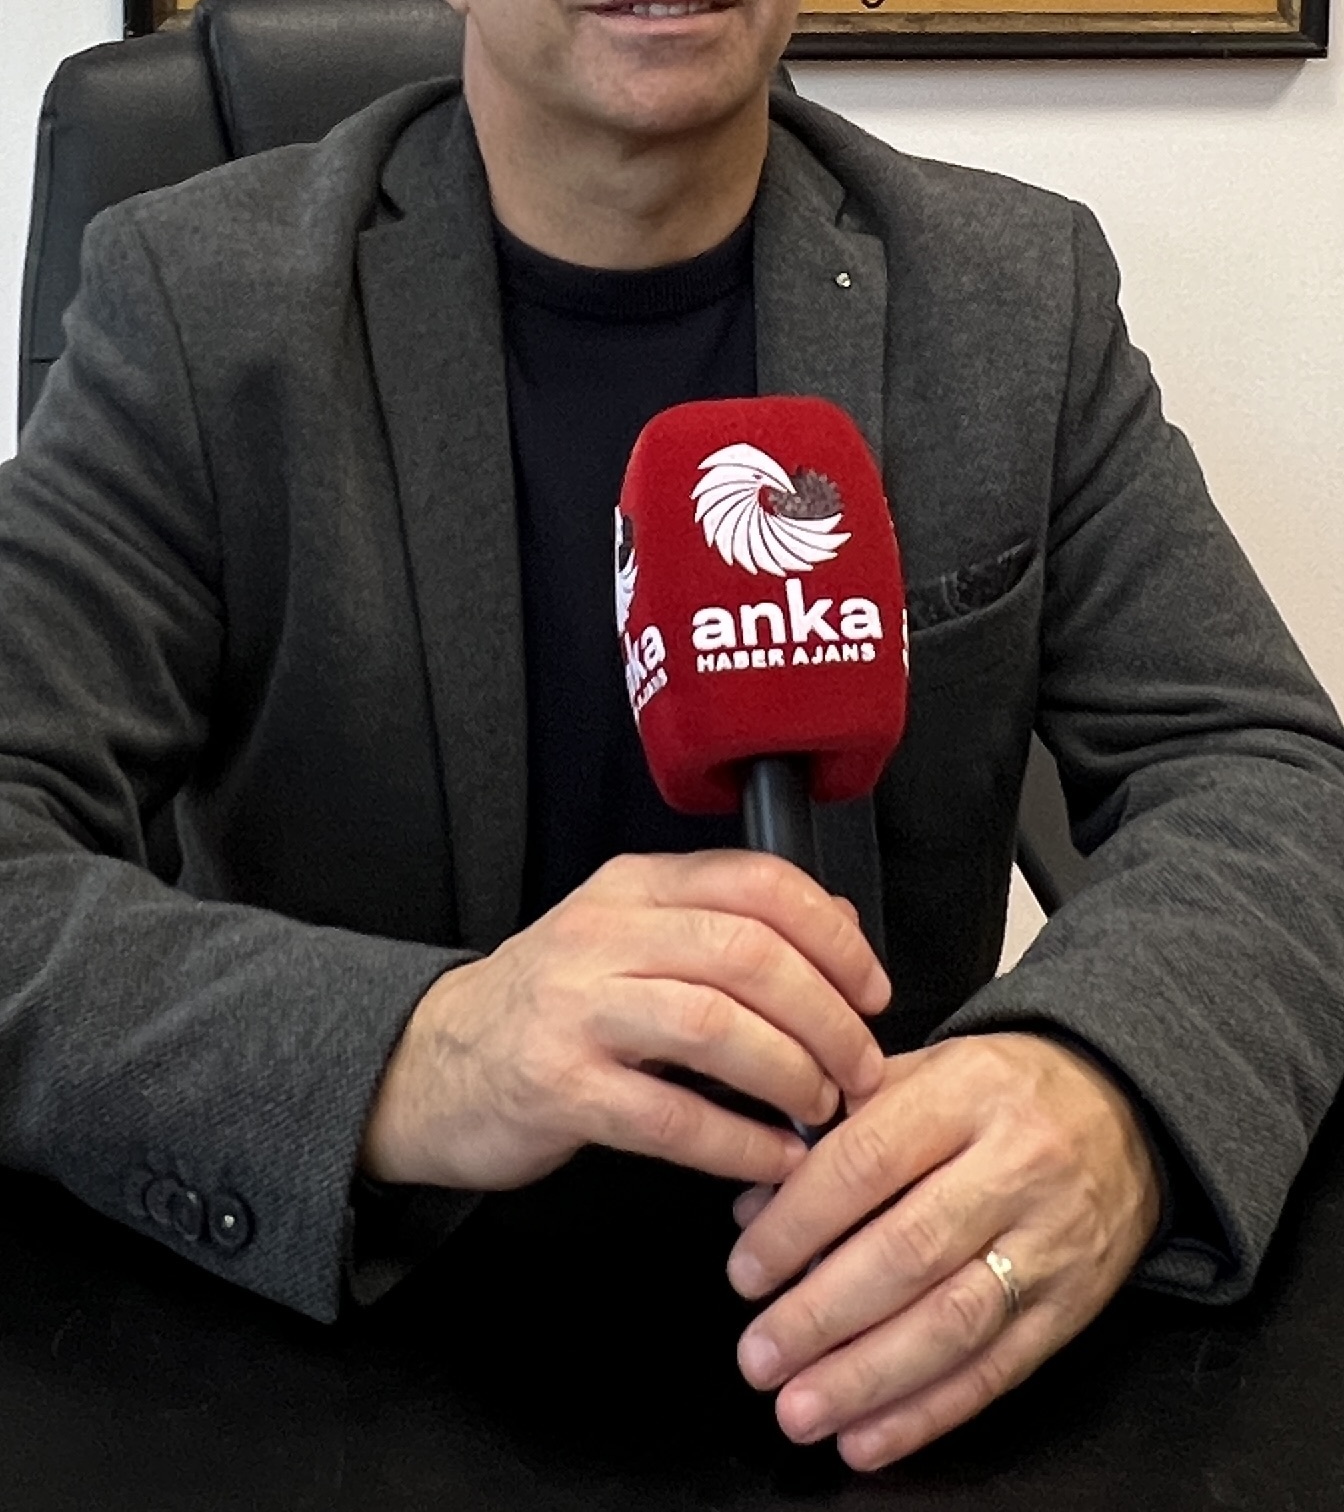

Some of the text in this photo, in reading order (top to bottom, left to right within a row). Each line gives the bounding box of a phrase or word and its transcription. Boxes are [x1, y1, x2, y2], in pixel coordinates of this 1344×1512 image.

[692, 578, 884, 651] anka
[696, 642, 877, 674] HABER AJANS
